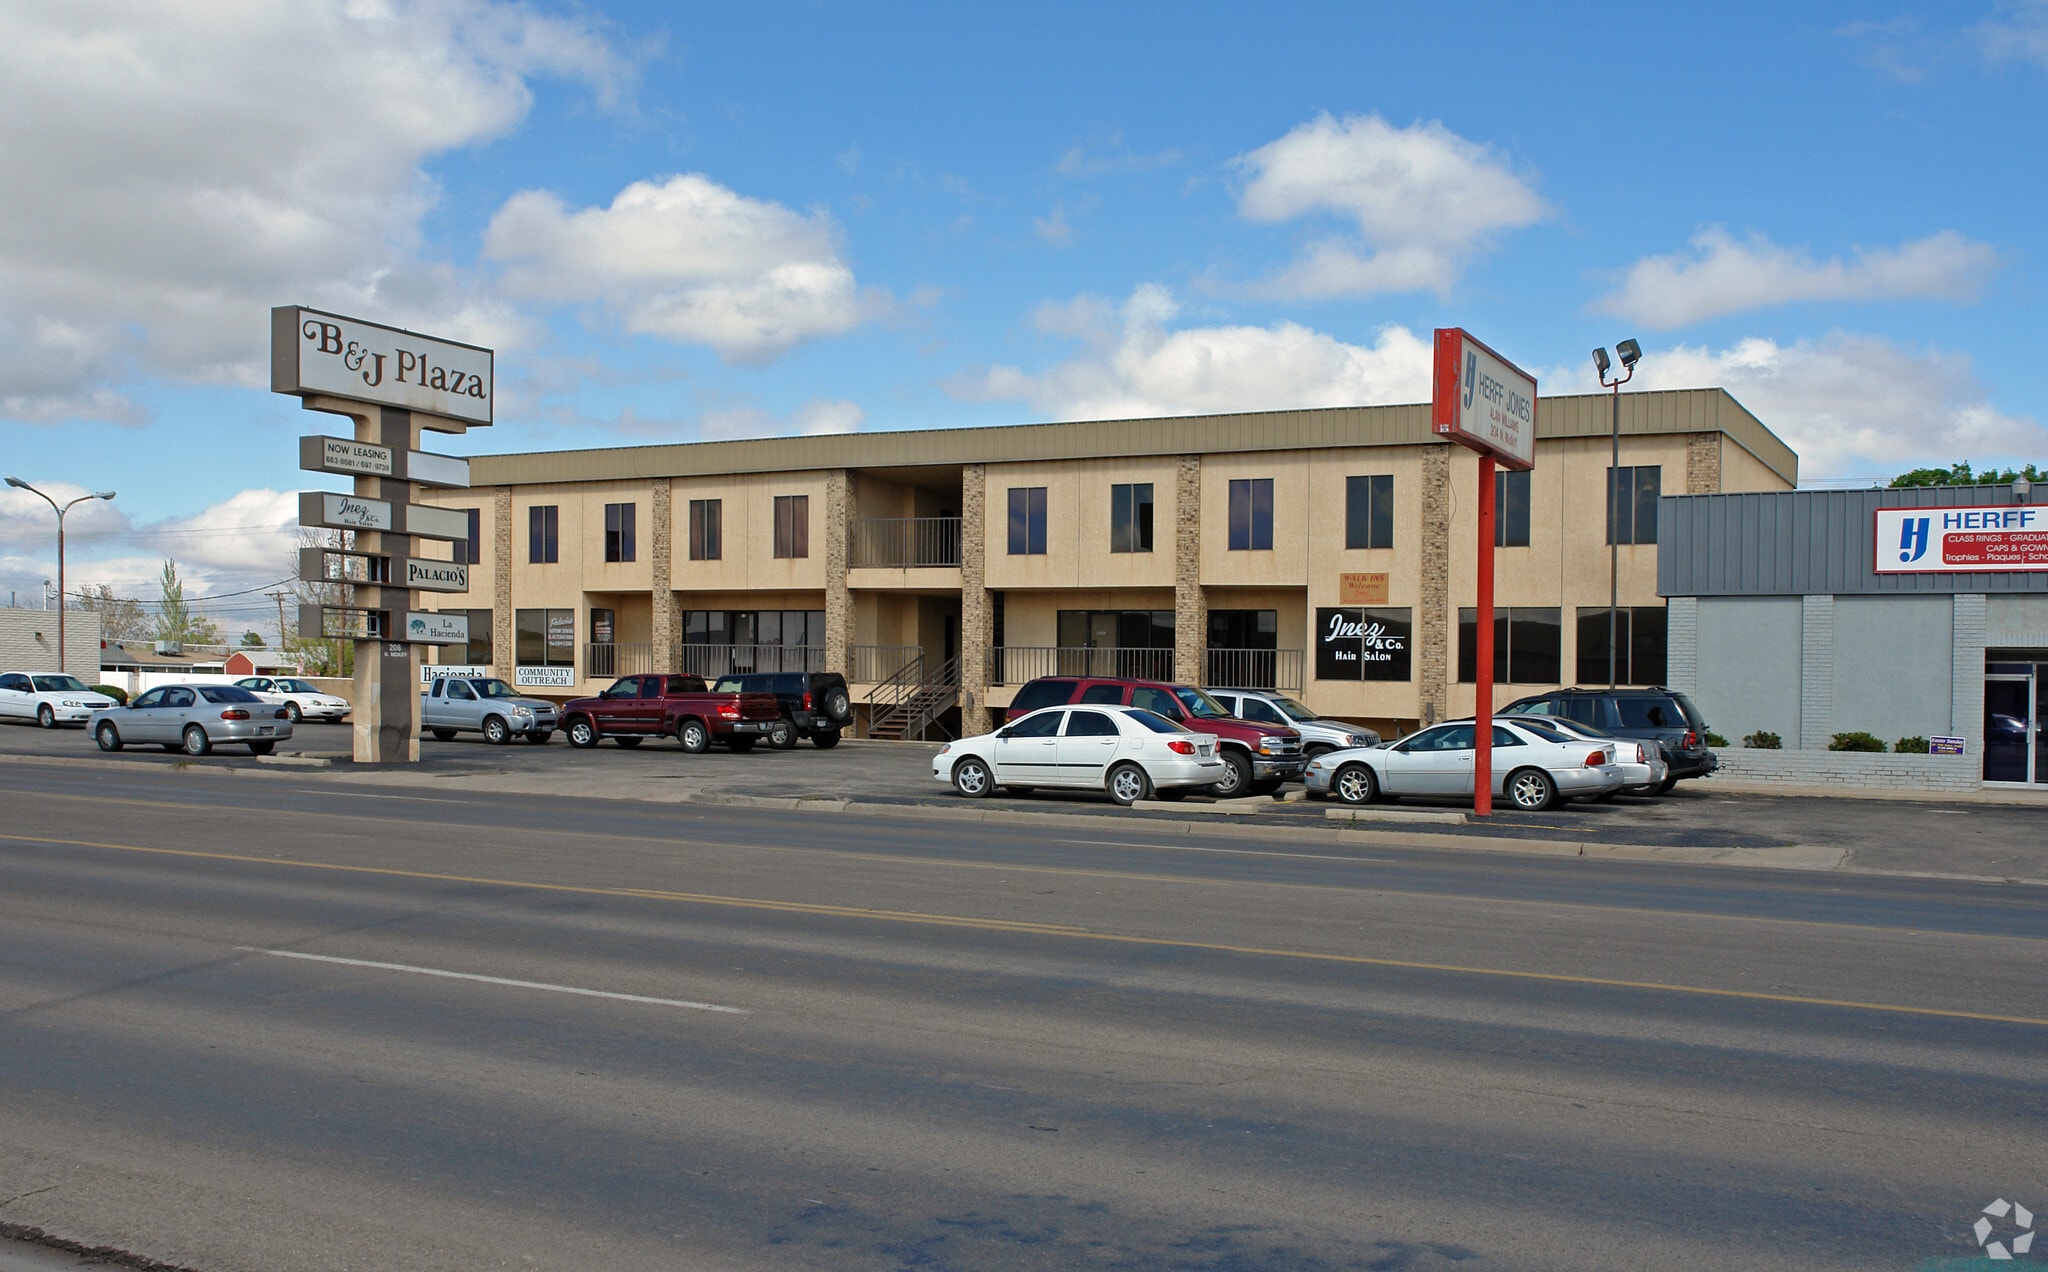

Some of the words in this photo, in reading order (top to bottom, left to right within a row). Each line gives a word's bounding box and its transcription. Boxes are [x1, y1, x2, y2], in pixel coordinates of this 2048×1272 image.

[395, 349, 487, 399] Plaza
[1478, 372, 1504, 407] HERFF
[1506, 390, 1530, 423] JONES
[327, 443, 350, 454] NOW
[353, 447, 387, 460] LEASING
[338, 497, 370, 520] Inez
[1943, 511, 2036, 529] HERFF
[1947, 535, 1975, 543] CLASS
[1975, 534, 2002, 542] RINGS
[1986, 544, 2009, 552] CAPS
[1945, 553, 1980, 562] Trophies
[1986, 553, 2021, 562] Plaques
[409, 563, 466, 587] PALACIO'S
[443, 619, 453, 629] La
[1325, 613, 1386, 647] Inez
[430, 626, 465, 639] Hacienda
[518, 668, 571, 677] COMMUNITY
[521, 676, 567, 685] OUTREACH
